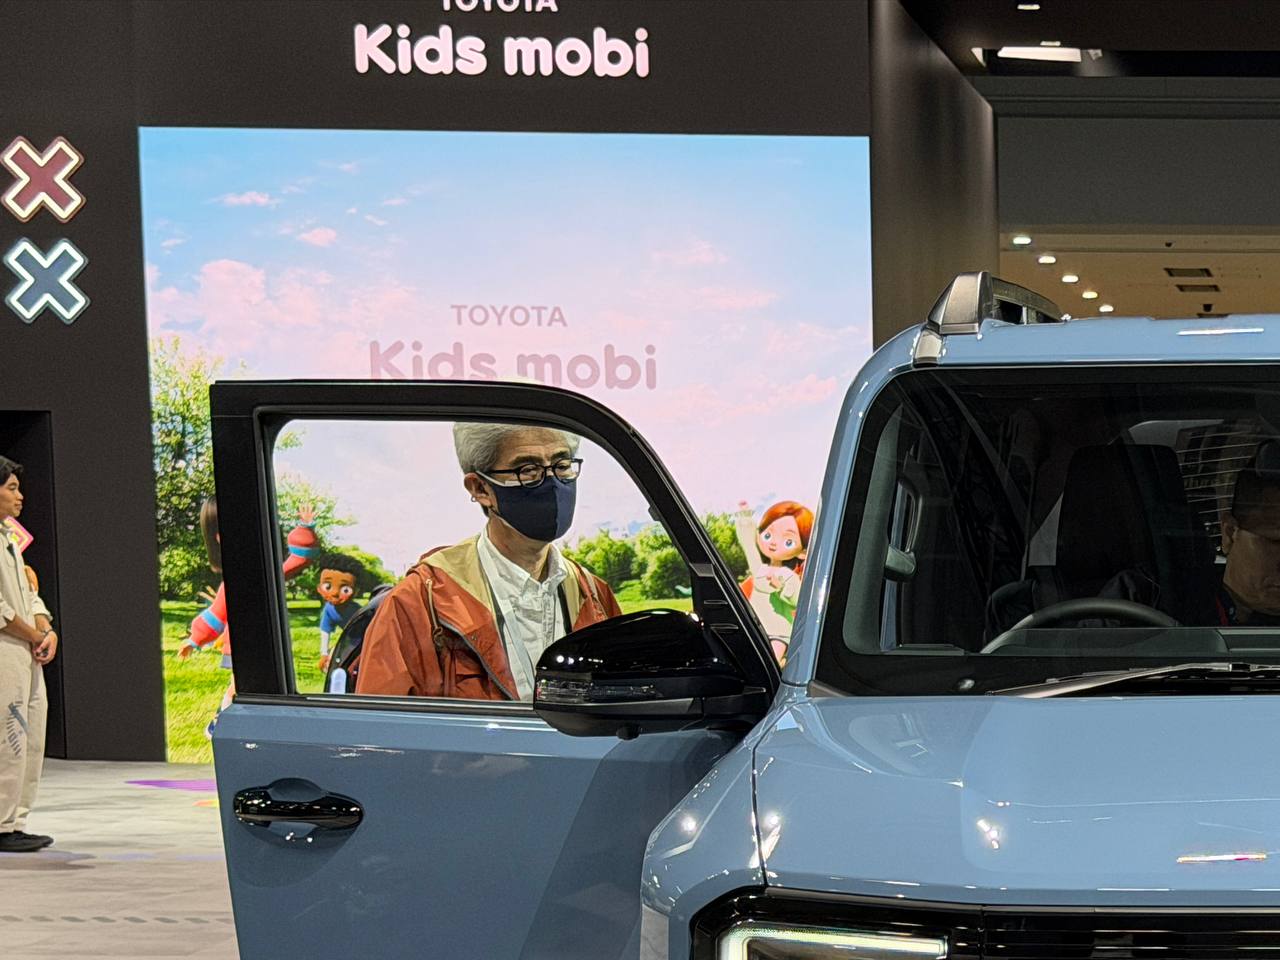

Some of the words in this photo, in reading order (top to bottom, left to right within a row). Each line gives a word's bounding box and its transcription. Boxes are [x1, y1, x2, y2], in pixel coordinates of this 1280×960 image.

[354, 23, 488, 75] Kids
[504, 27, 650, 78] mobi
[450, 304, 568, 327] TOYOTA
[369, 340, 498, 379] Kids
[516, 343, 657, 390] mobi
